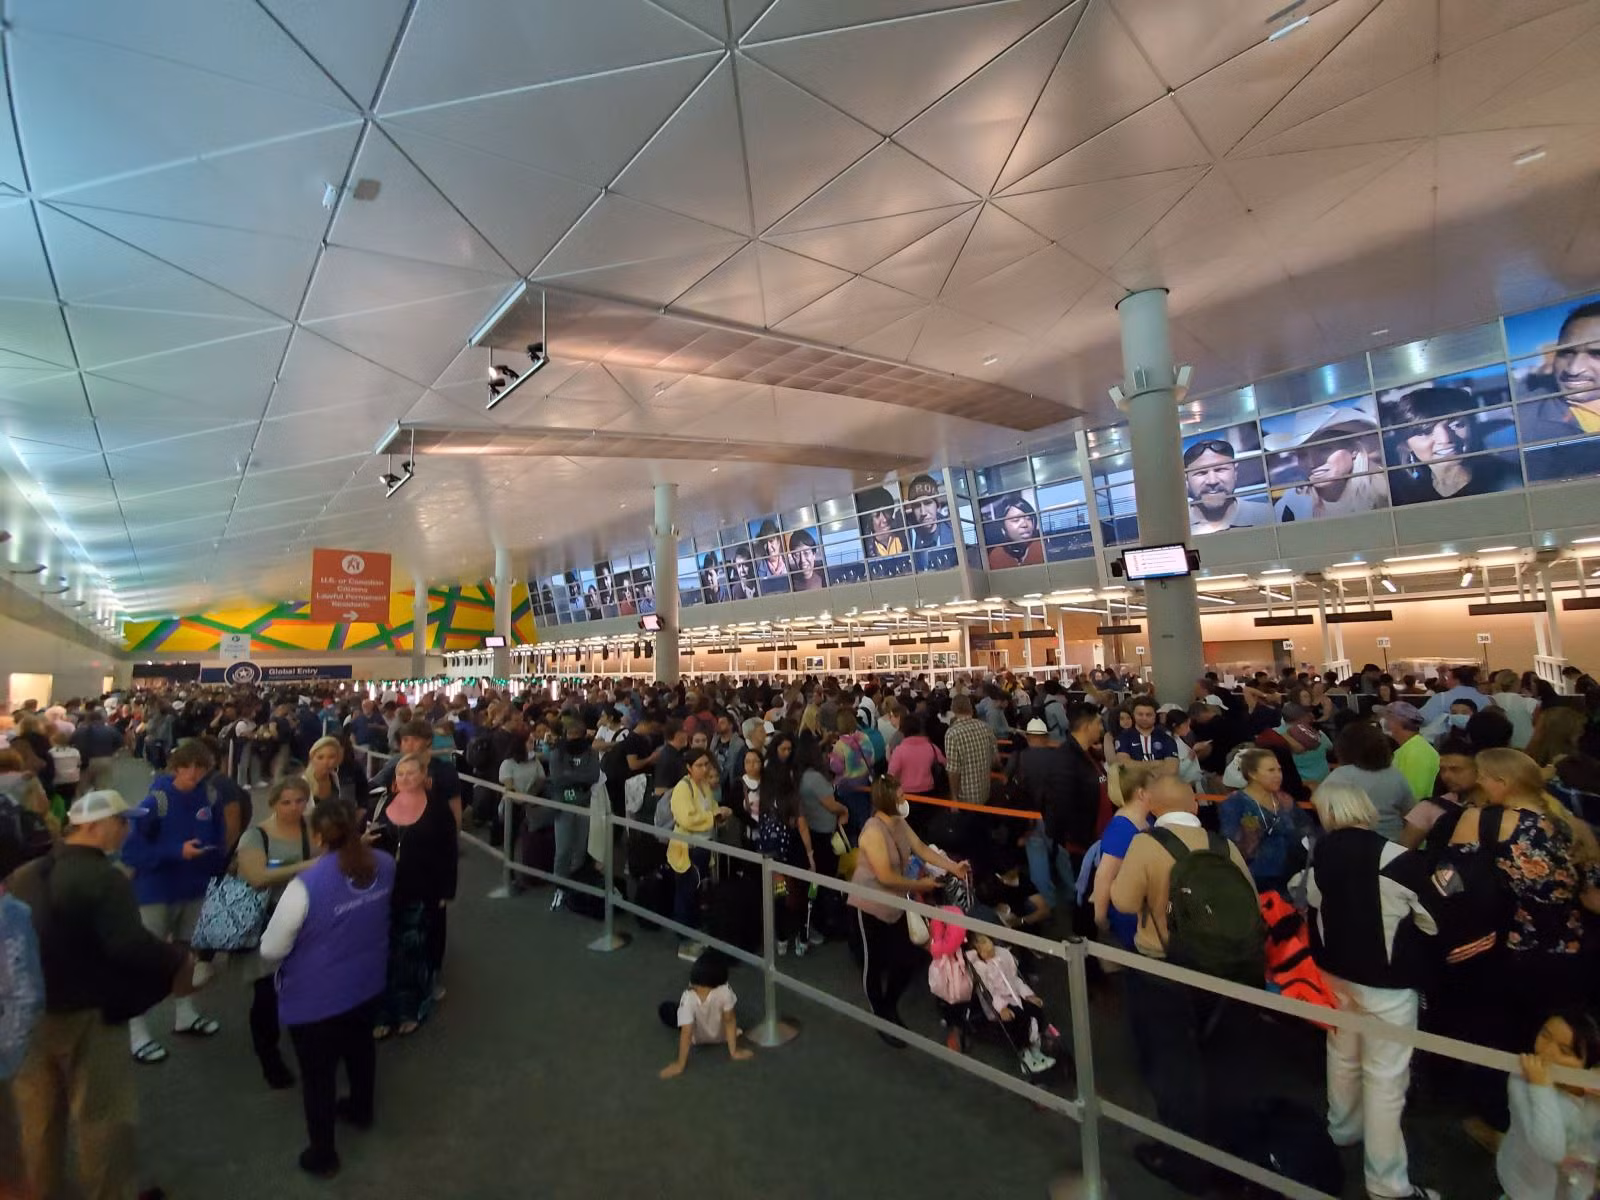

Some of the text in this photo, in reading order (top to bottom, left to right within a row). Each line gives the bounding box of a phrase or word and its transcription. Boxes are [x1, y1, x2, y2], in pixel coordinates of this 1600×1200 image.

[348, 577, 384, 586] Canadian
[337, 585, 368, 593] Citizens
[316, 592, 387, 601] Lawful Permanent
[298, 667, 318, 676] Entry
